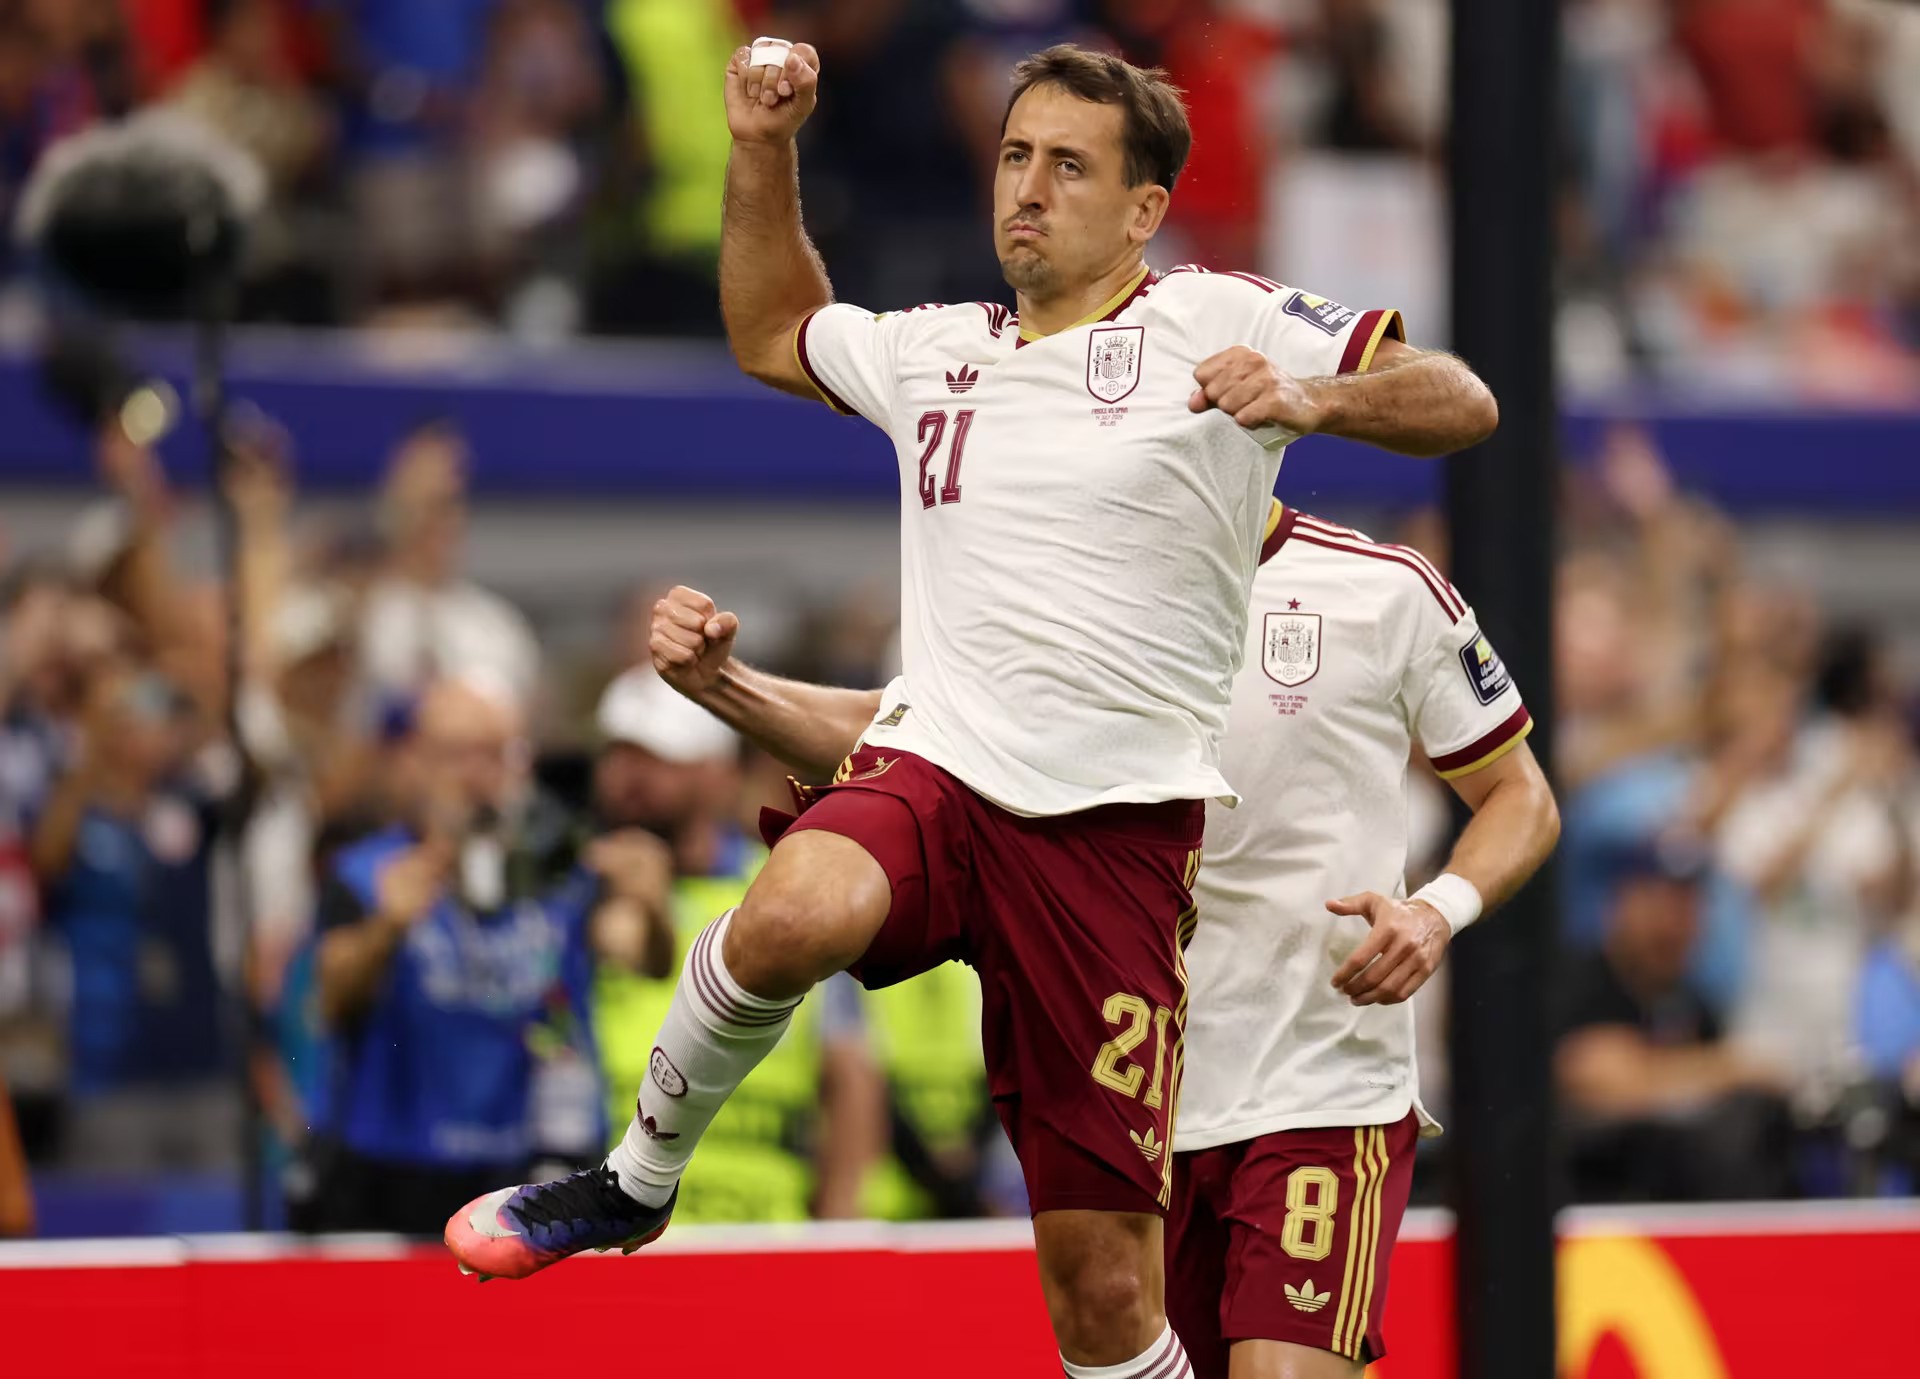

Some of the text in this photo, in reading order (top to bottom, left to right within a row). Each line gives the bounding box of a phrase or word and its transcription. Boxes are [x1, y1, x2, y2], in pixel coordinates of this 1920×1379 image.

[917, 409, 976, 510] 21
[1090, 991, 1172, 1110] 21
[1280, 1166, 1339, 1262] 8
